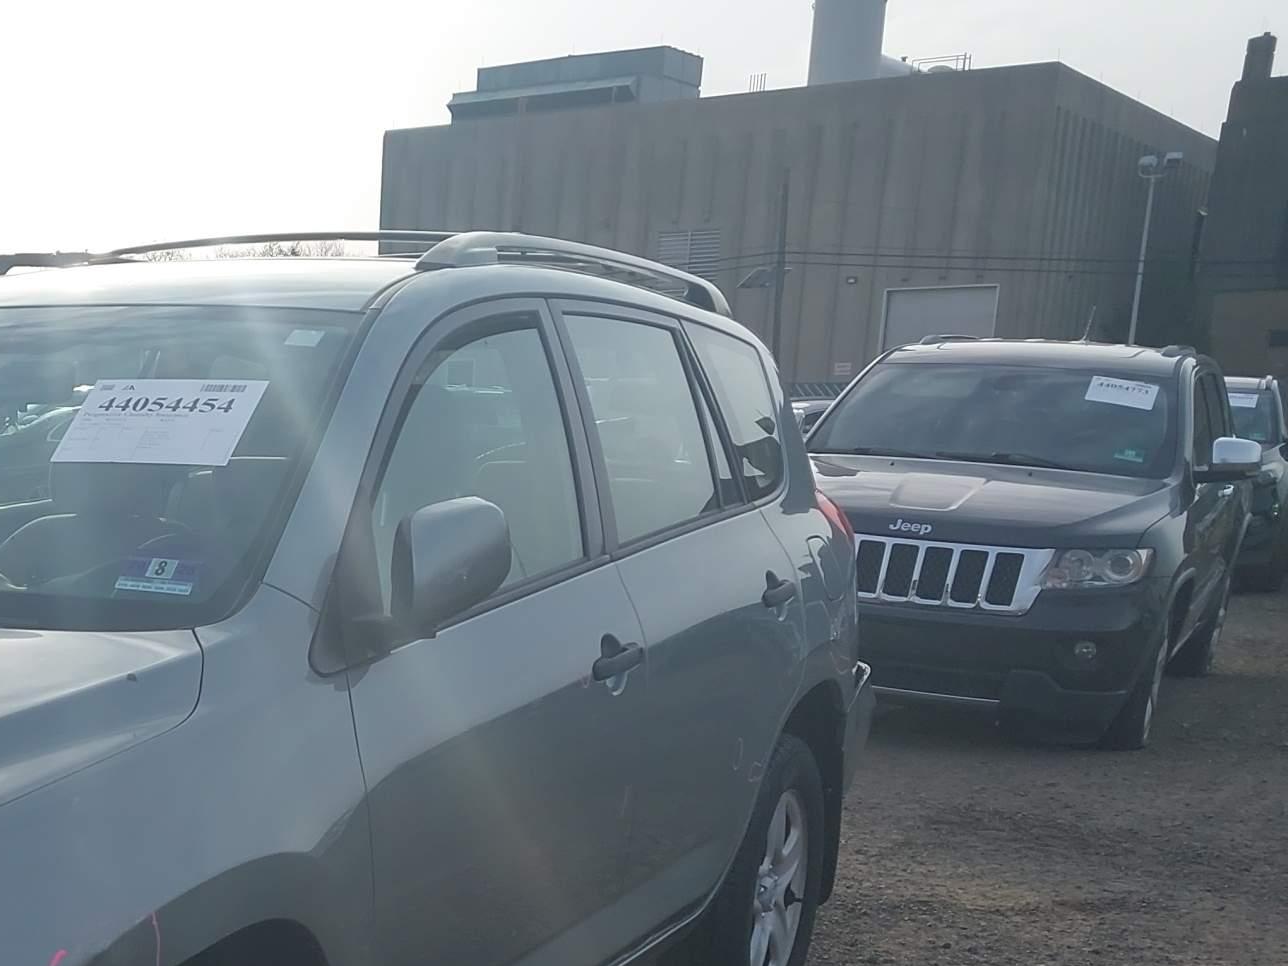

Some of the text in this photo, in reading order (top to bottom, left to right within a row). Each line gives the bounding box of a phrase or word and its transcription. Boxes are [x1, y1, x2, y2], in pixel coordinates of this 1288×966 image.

[98, 397, 236, 413] 44054454
[889, 519, 932, 535] Jeep
[154, 560, 168, 576] 8
